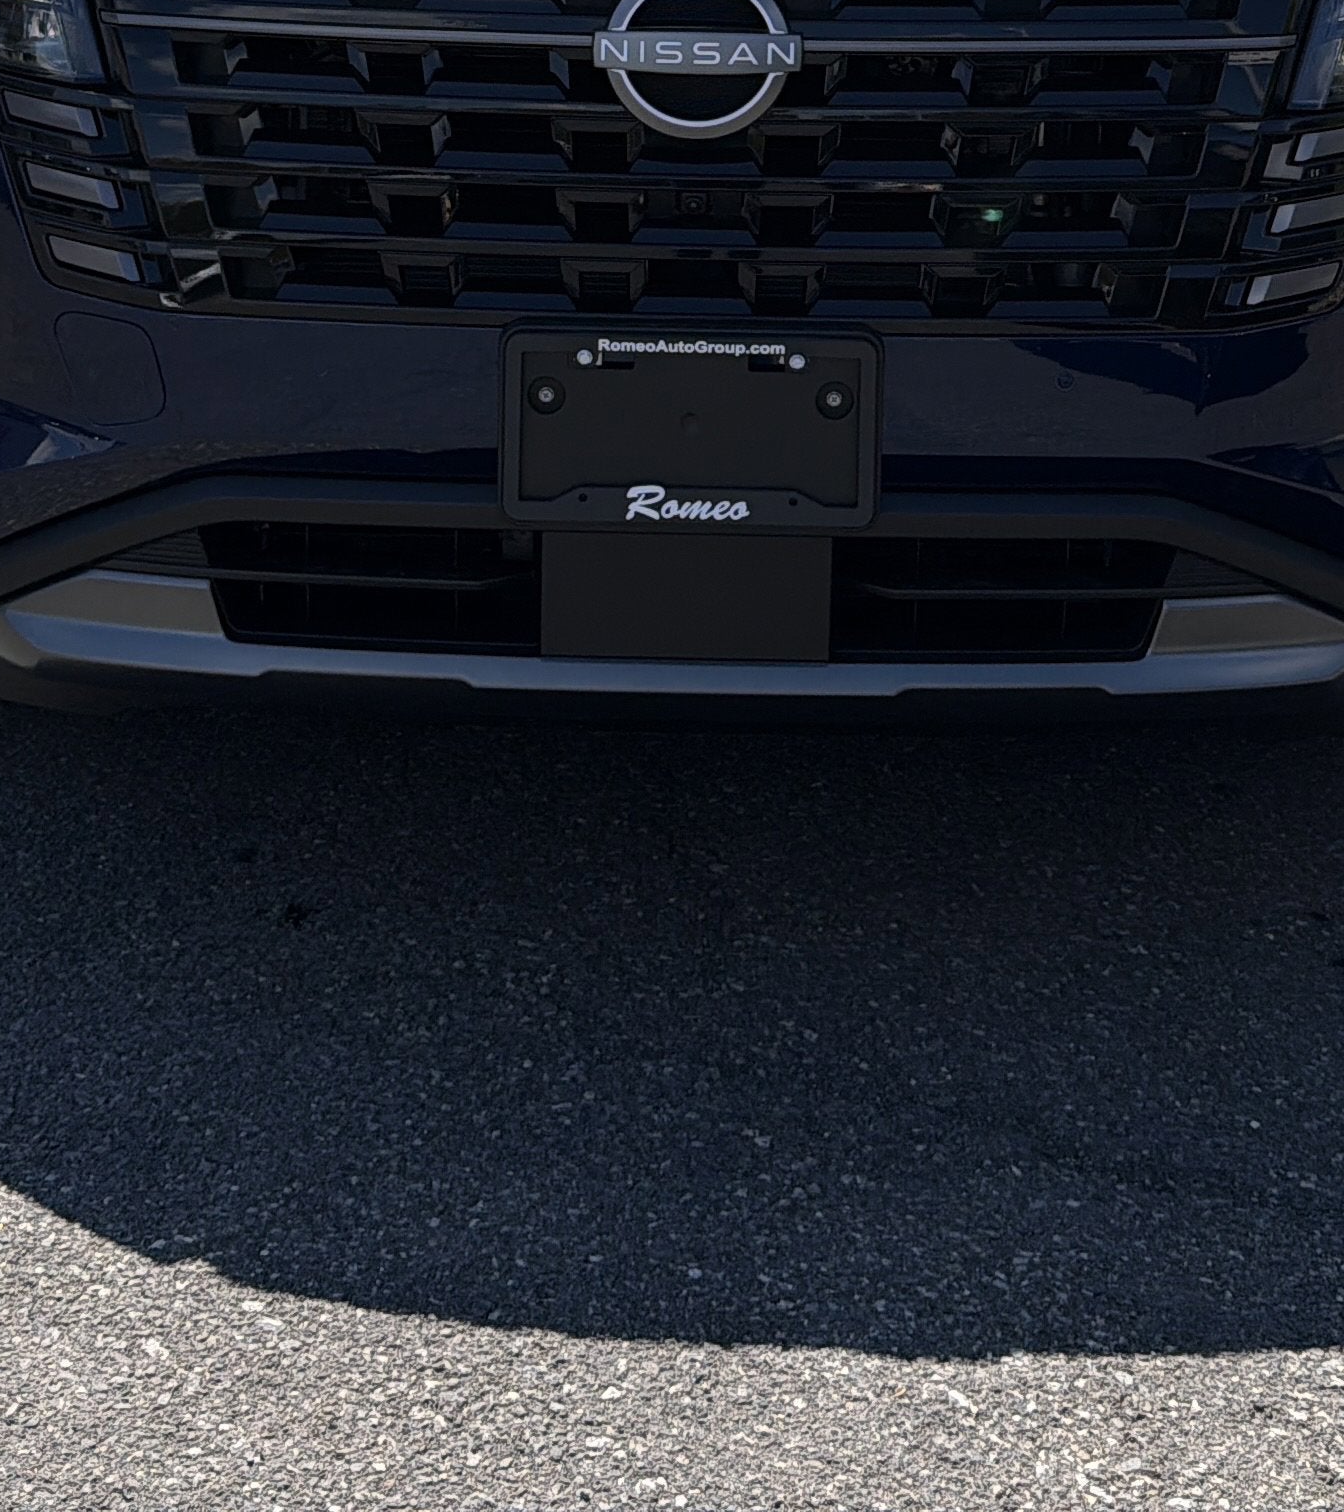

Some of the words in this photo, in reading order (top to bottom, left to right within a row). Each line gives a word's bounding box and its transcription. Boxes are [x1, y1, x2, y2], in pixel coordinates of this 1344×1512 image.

[600, 38, 795, 66] NISSAN
[597, 338, 786, 357] RomeoAutoGroup.com
[625, 484, 751, 521] Romeo
